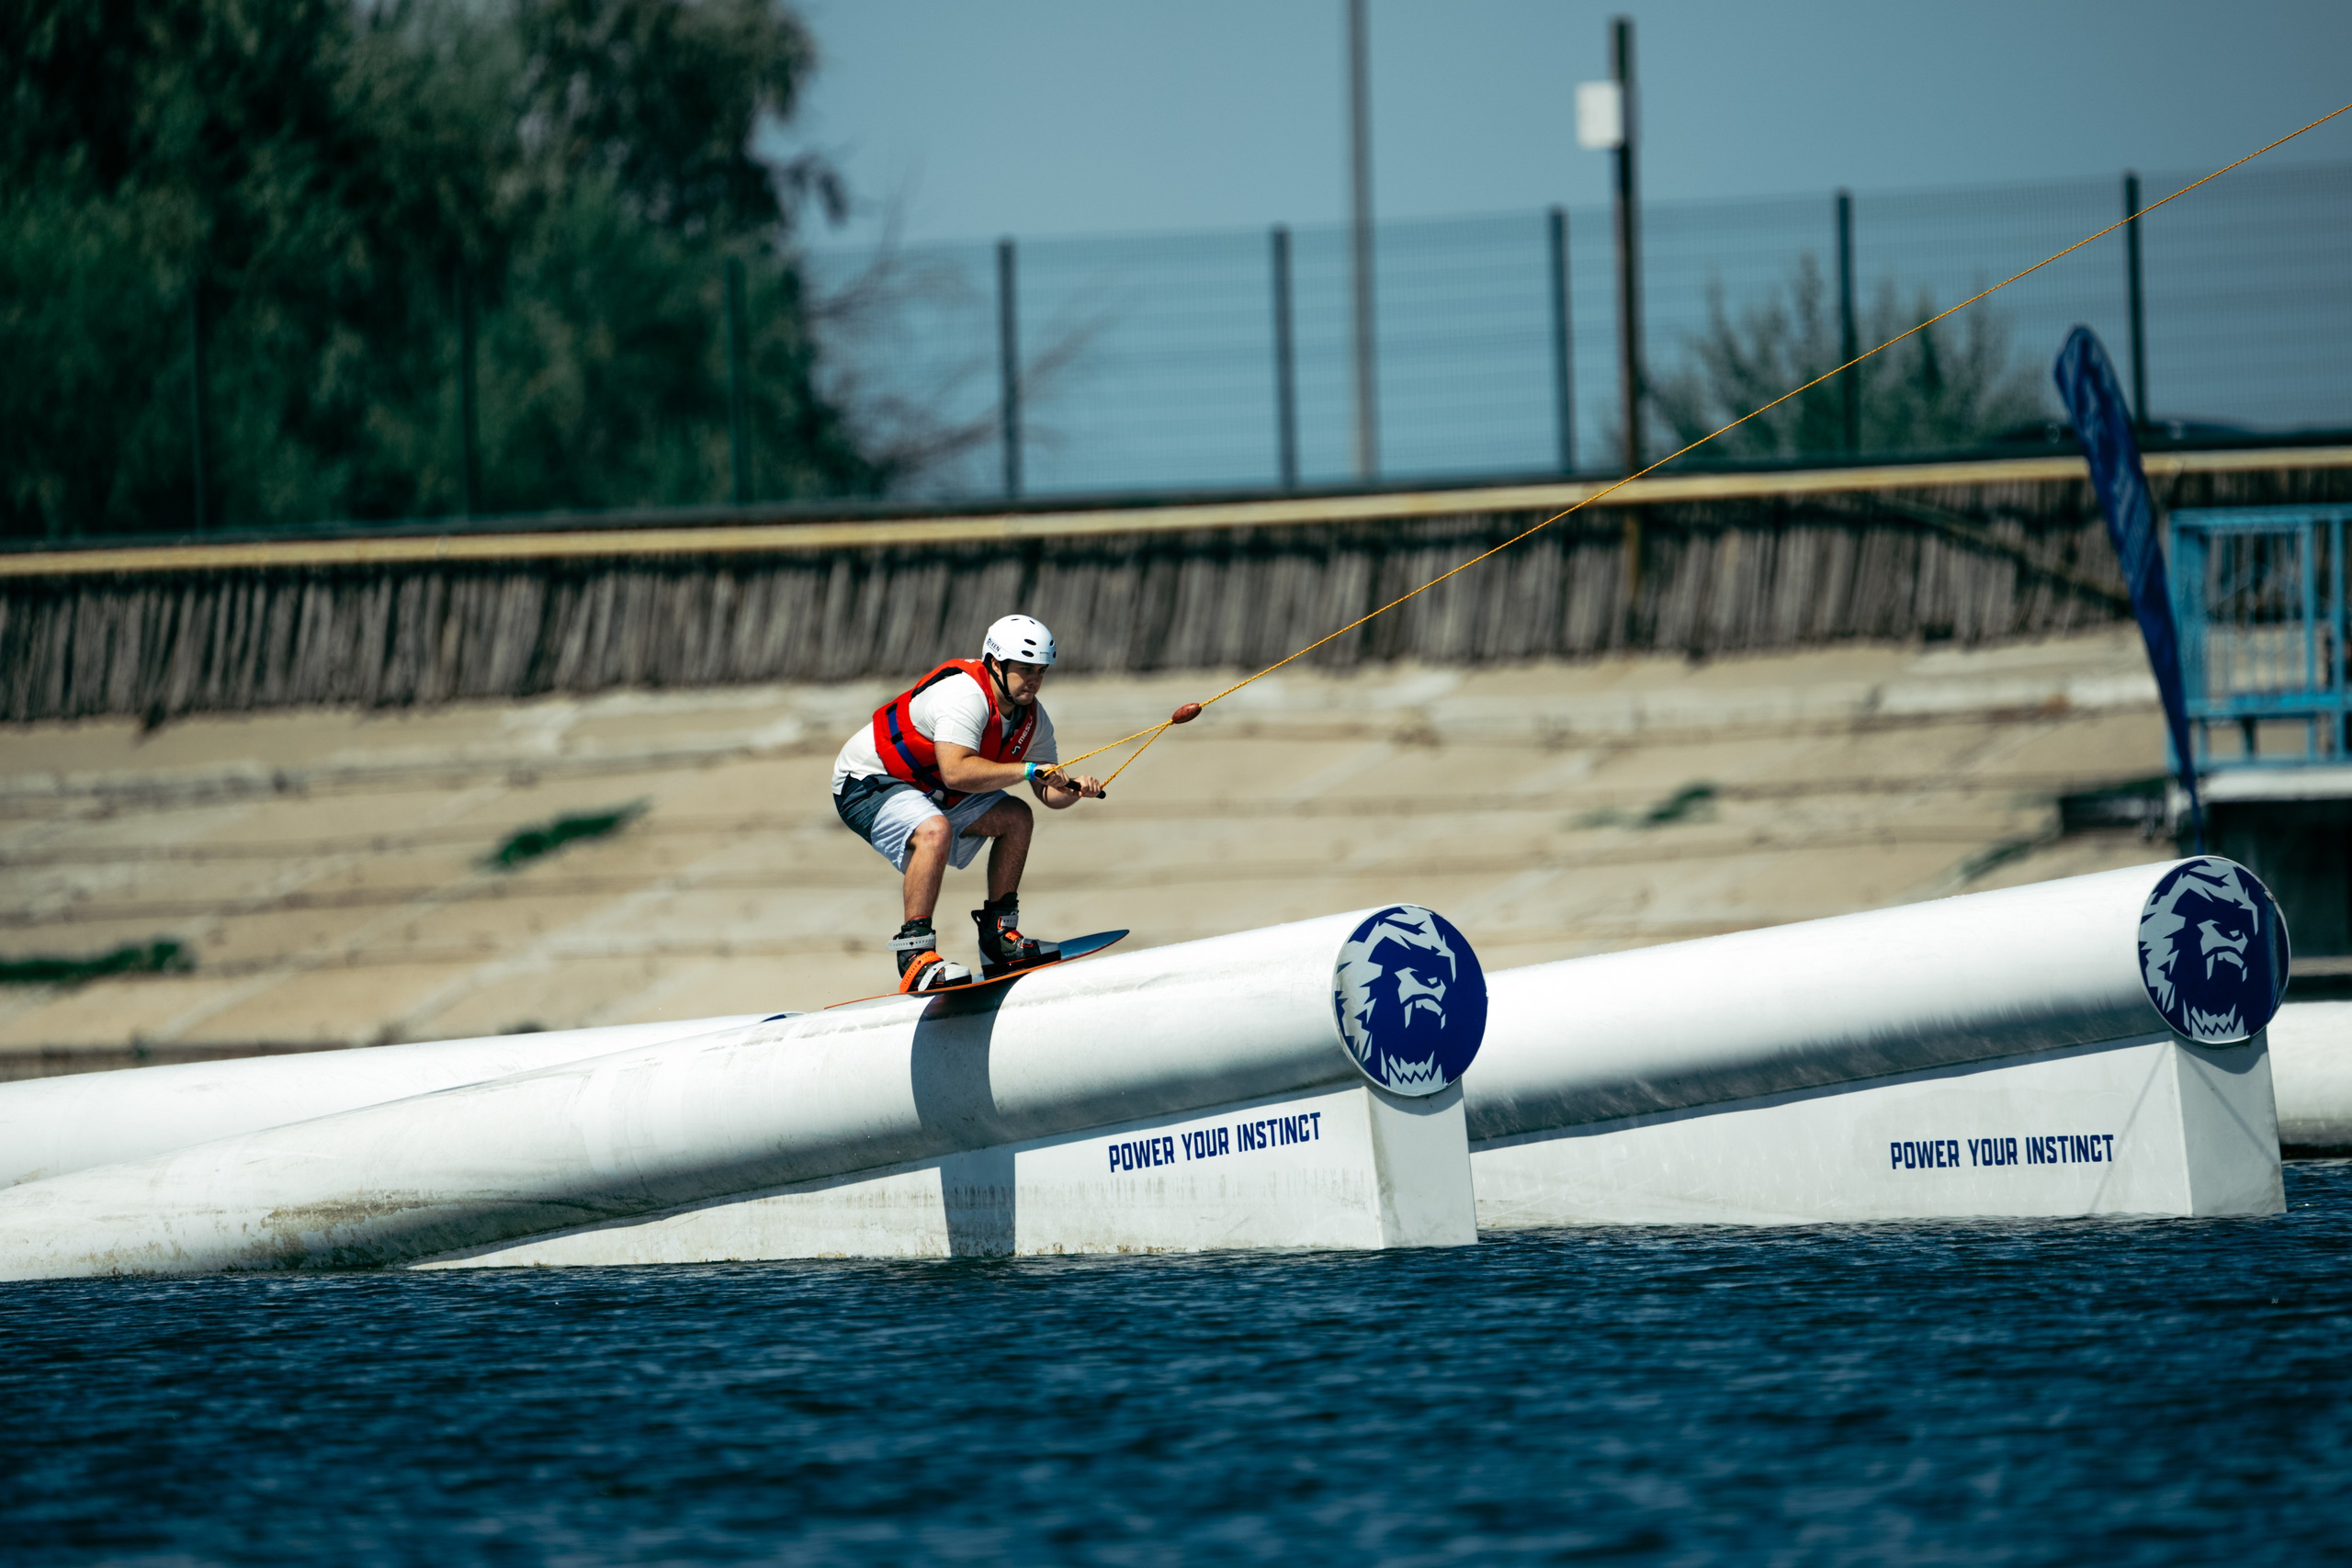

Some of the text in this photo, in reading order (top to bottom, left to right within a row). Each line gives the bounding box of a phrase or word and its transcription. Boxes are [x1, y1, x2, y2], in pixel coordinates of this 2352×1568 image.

[1108, 1111, 1321, 1173] POWER YOUR INSTINCT
[1890, 1134, 2114, 1170] POWER YOUR INSTINCT
